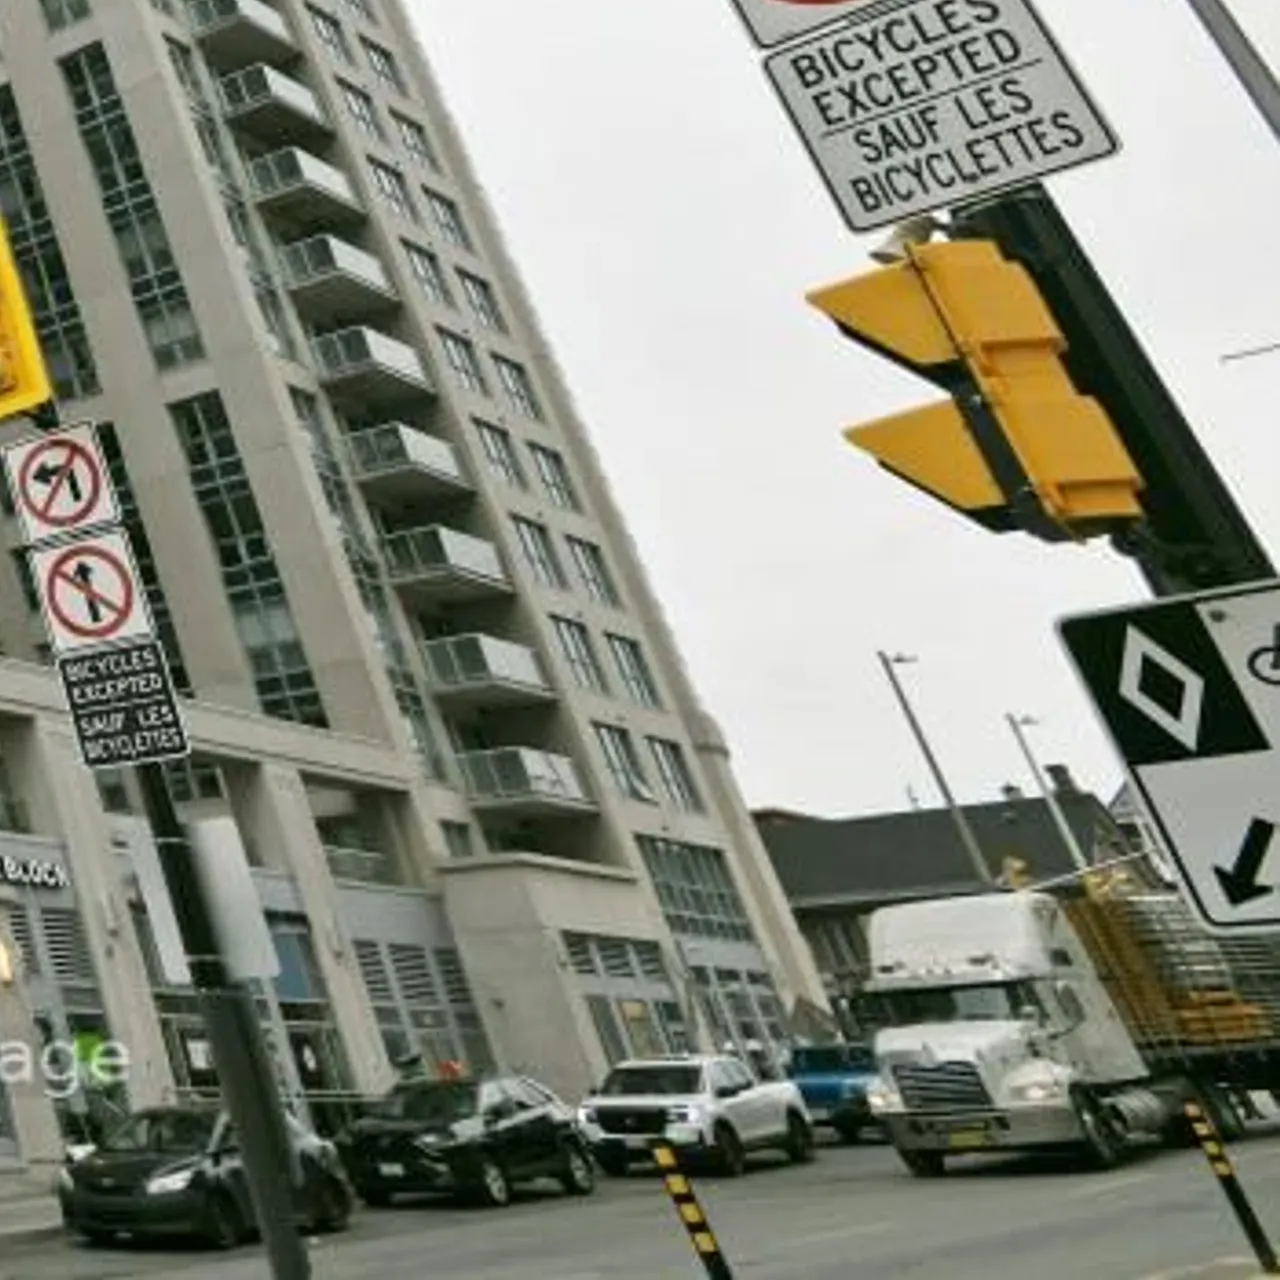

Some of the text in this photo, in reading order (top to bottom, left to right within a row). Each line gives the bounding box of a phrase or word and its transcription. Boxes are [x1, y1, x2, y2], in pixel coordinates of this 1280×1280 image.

[812, 28, 1021, 126] EXCEPTED
[853, 79, 1033, 163] SAUF LES
[850, 110, 1084, 213] BICYCLETTES
[66, 647, 156, 682] BICYCLES
[72, 673, 162, 704] EXCEPTED
[4, 855, 71, 887] BLOCK
